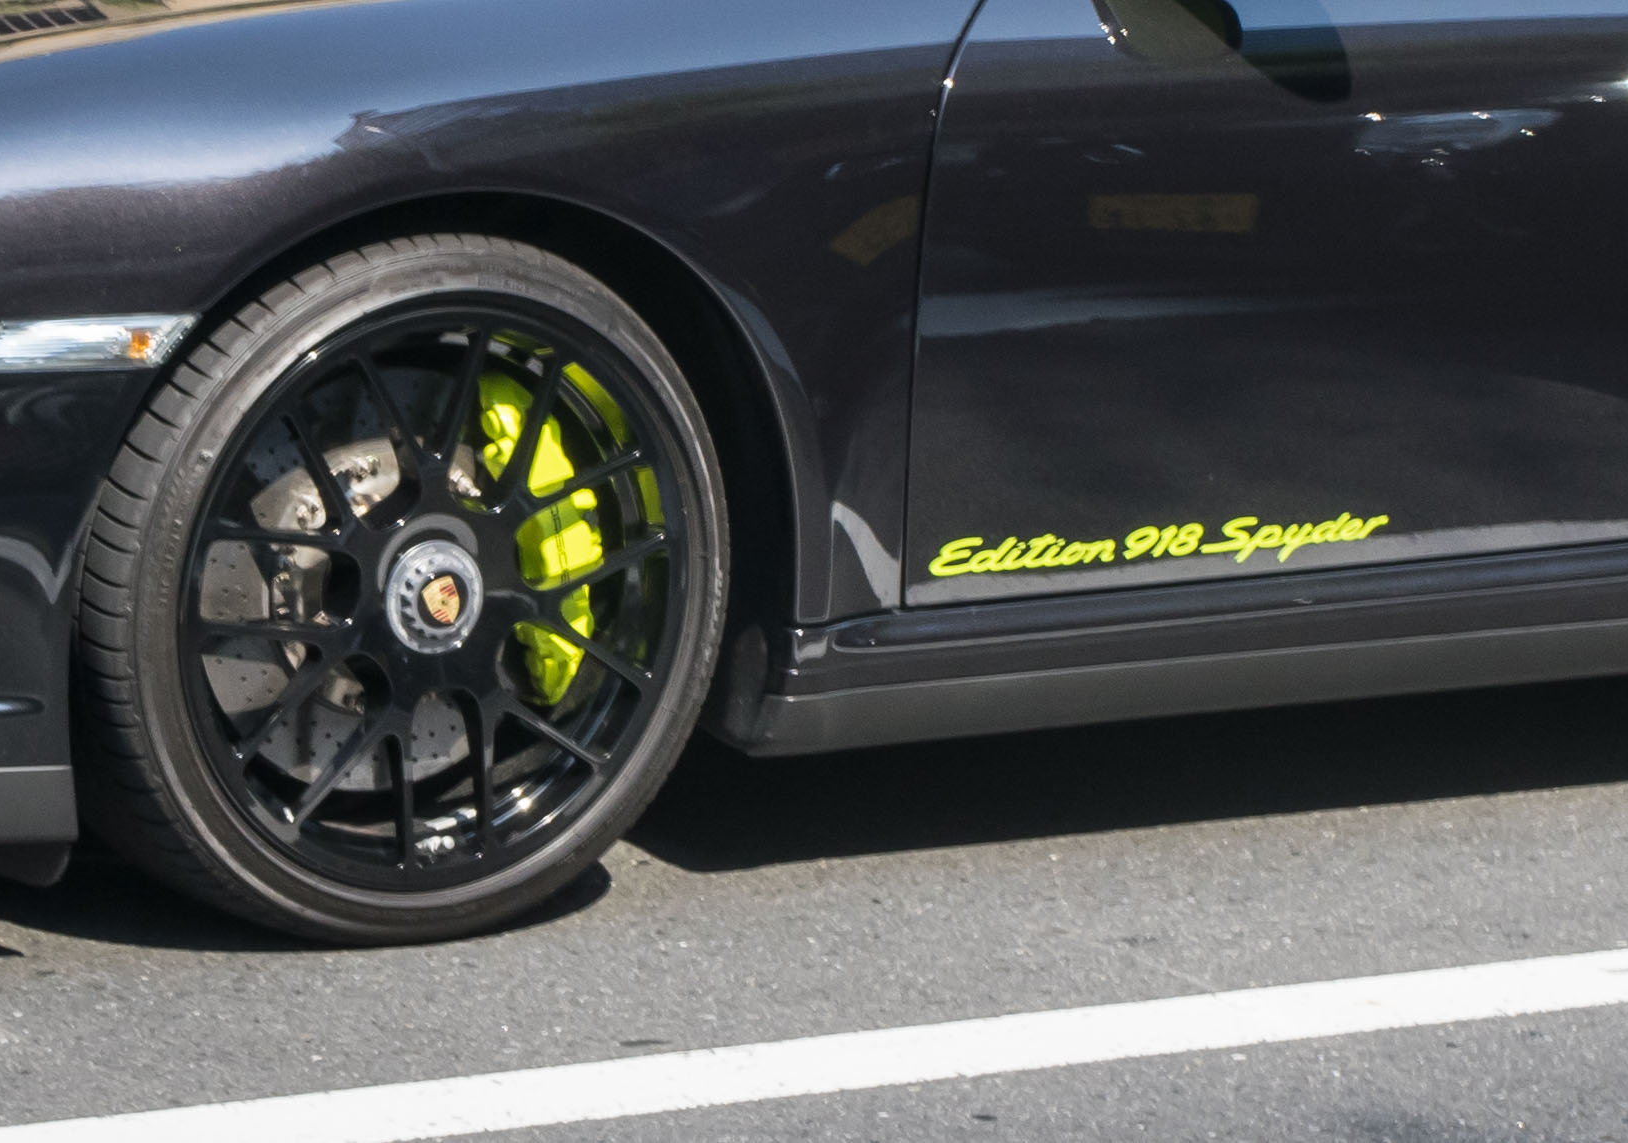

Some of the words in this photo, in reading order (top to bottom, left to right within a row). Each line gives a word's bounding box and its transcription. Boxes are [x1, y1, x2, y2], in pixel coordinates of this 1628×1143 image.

[929, 534, 1116, 576] Edition
[1123, 523, 1204, 559] 918
[1201, 512, 1389, 563] Spyder
